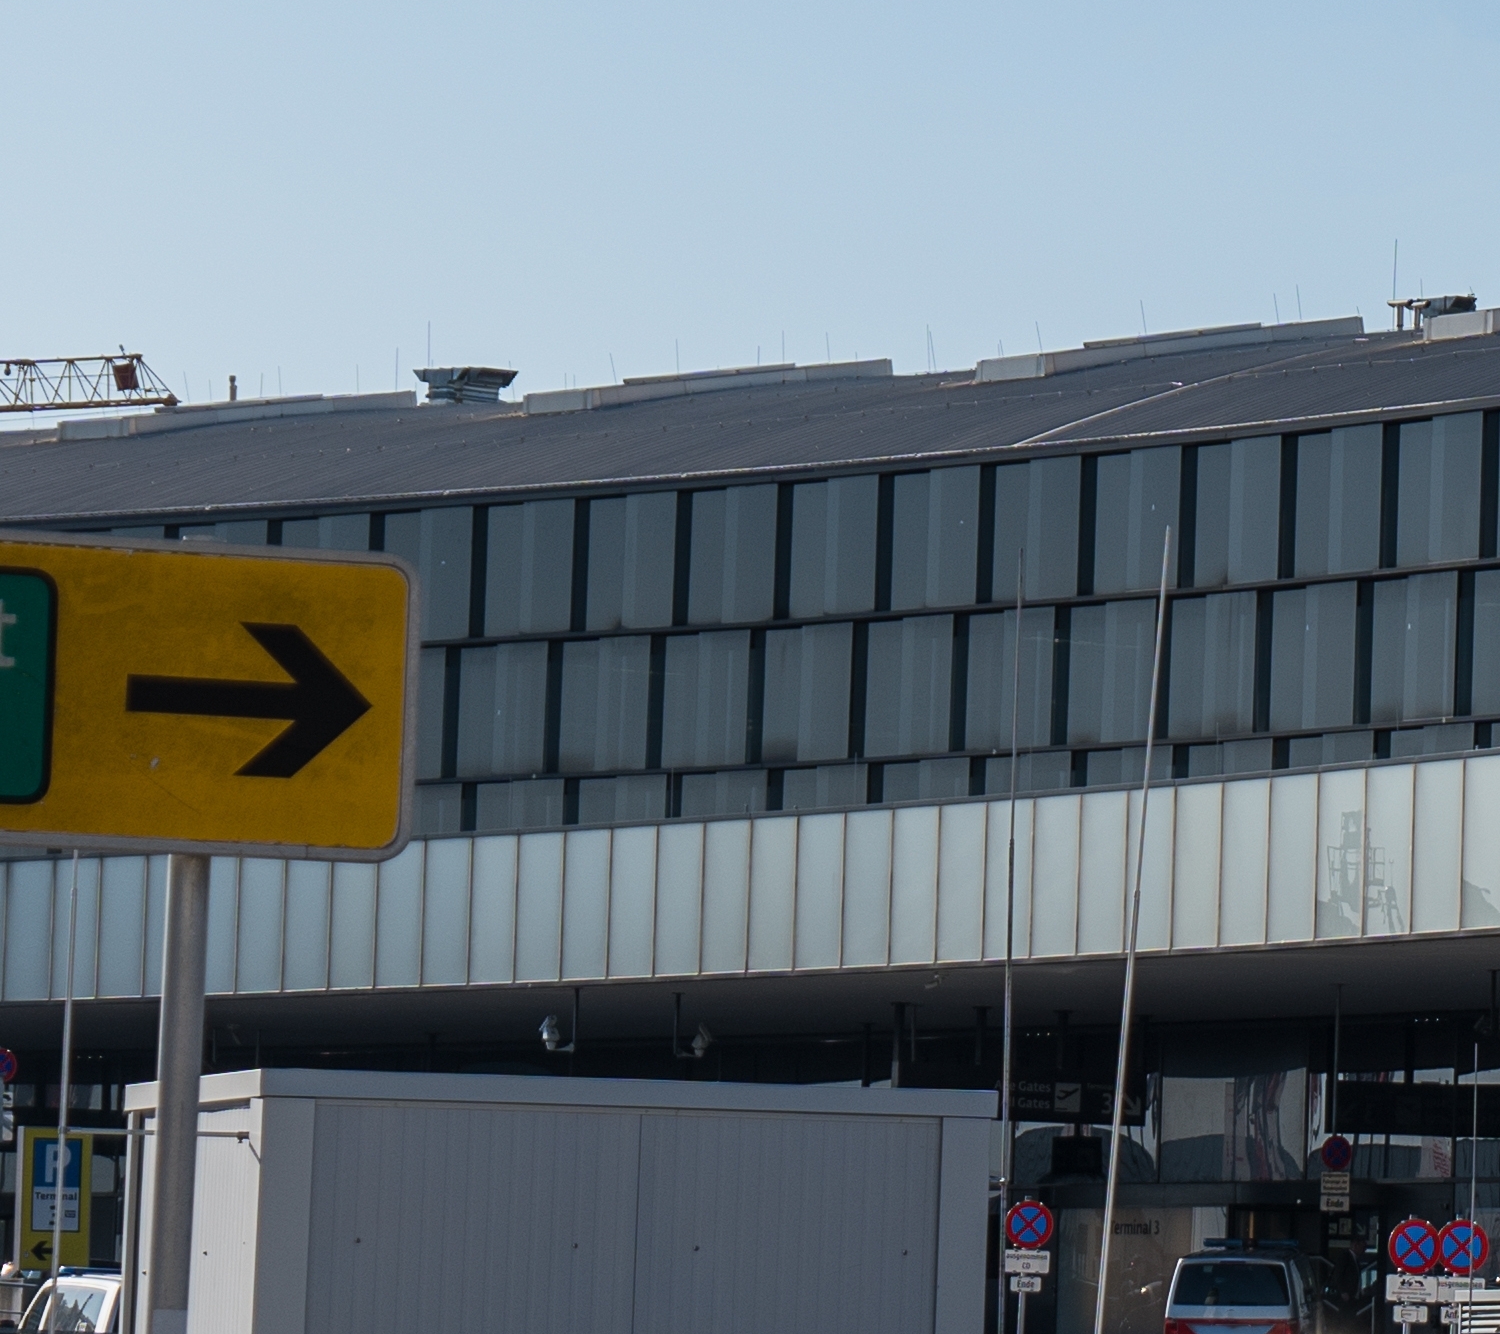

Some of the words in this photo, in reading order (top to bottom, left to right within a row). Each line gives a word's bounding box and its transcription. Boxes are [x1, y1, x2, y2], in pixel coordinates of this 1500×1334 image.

[1018, 1080, 1051, 1092] Gates
[1017, 1097, 1050, 1109] Gates
[1101, 1093, 1112, 1114] 3
[45, 1144, 71, 1183] P
[35, 1192, 77, 1200] Termnal
[1153, 1220, 1160, 1235] 3
[1016, 1279, 1035, 1289] Ende
[1438, 1280, 1483, 1289] usgenomen
